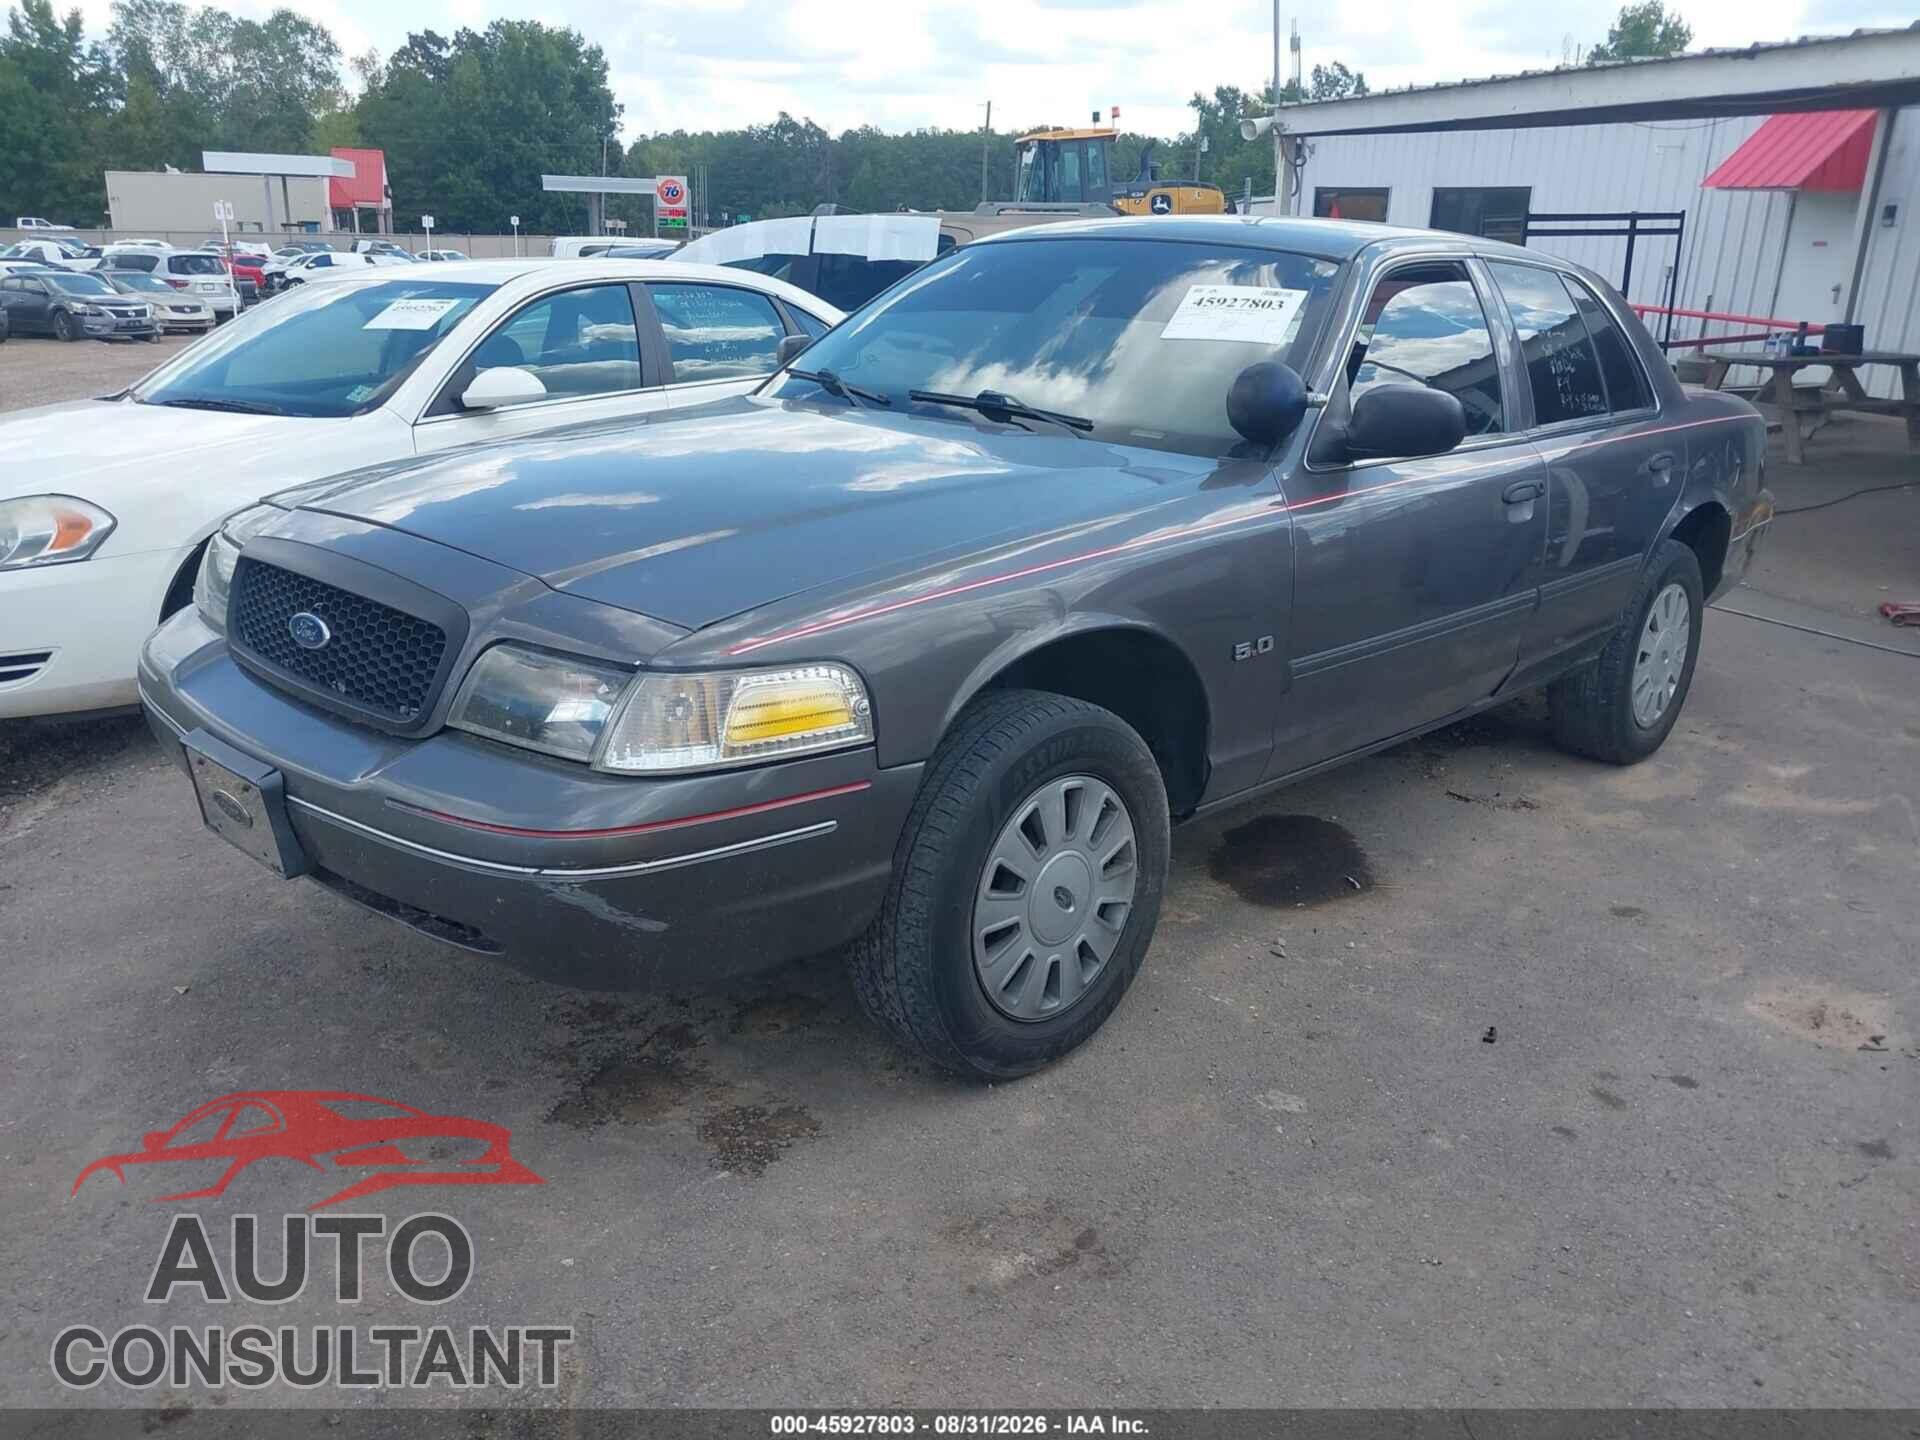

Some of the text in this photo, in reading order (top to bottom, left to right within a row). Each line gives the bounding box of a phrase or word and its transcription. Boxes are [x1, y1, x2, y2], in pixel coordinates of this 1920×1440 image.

[664, 185, 680, 198] 76
[1192, 296, 1285, 312] 45927803
[1234, 635, 1275, 661] 5.0
